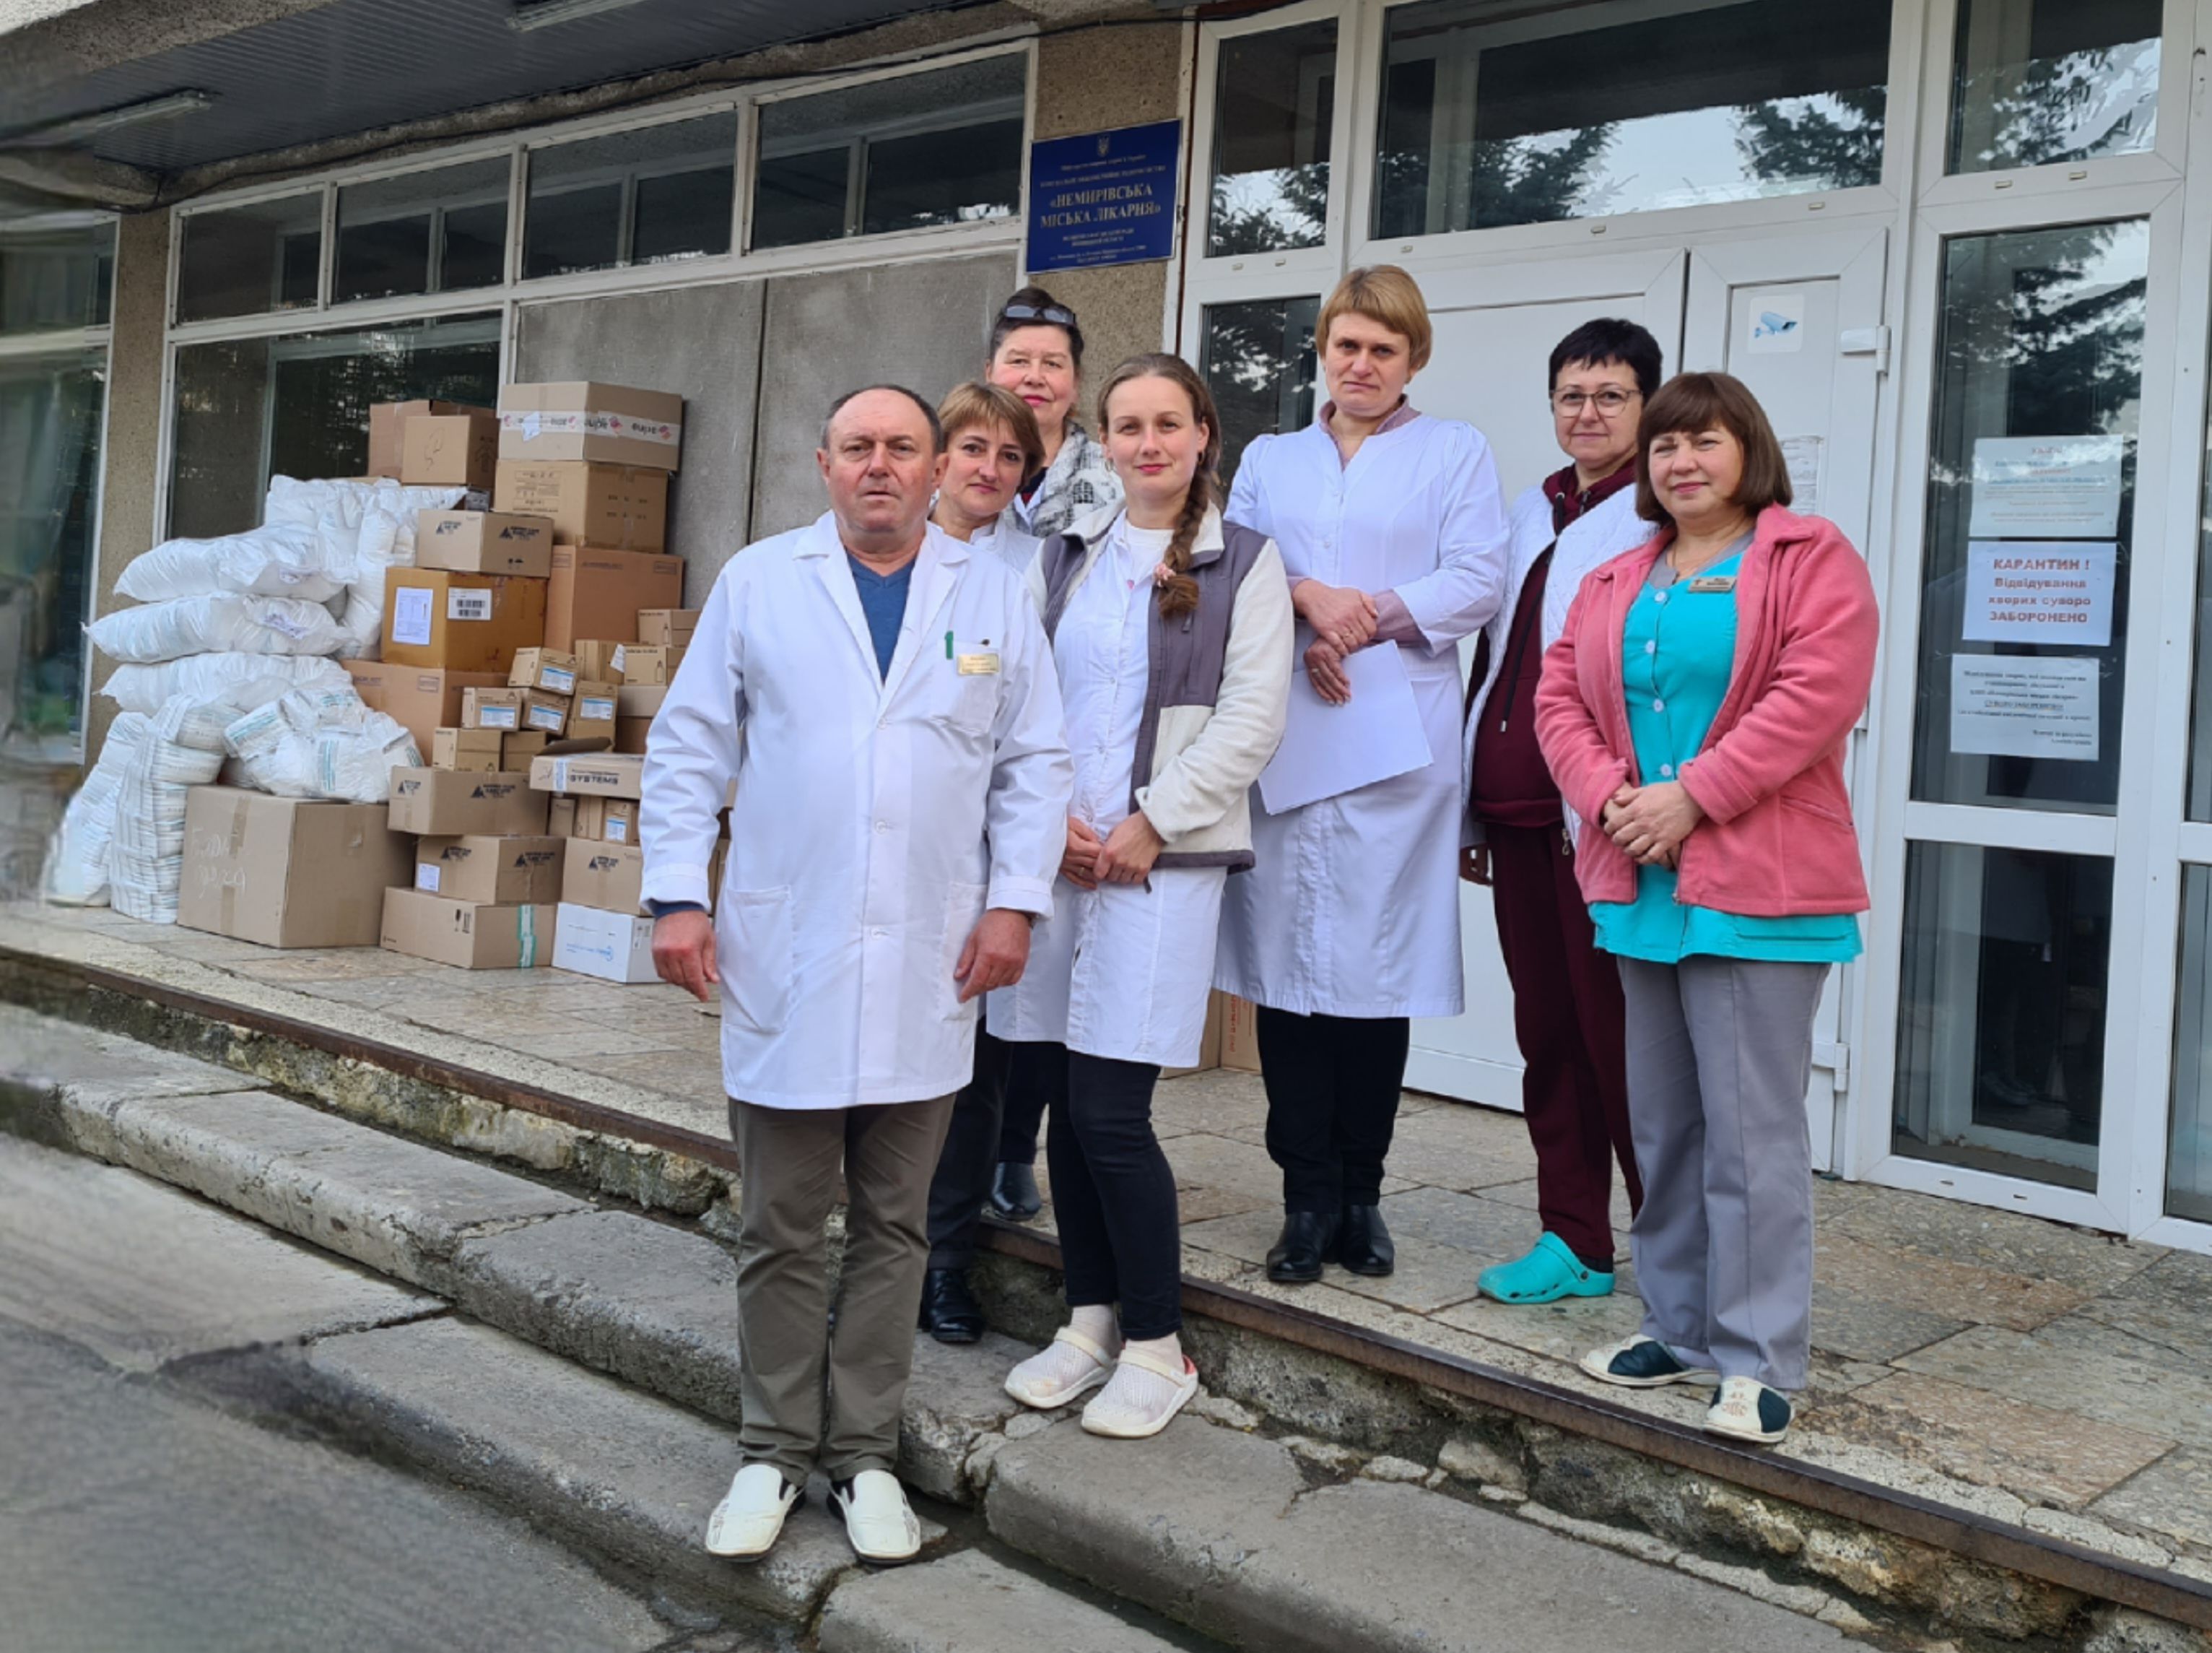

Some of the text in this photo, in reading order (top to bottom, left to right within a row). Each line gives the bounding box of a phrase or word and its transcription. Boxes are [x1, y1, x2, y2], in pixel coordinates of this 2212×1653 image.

[1040, 209, 1091, 228] МІСЬКА
[1993, 558, 2080, 570] КАРАНТИН
[1994, 577, 2086, 590] Відвідування
[1988, 597, 2091, 607] хворих суворо
[1989, 611, 2088, 622] ЗАБОРОНЕНО
[570, 774, 619, 786] SYSTEMS
